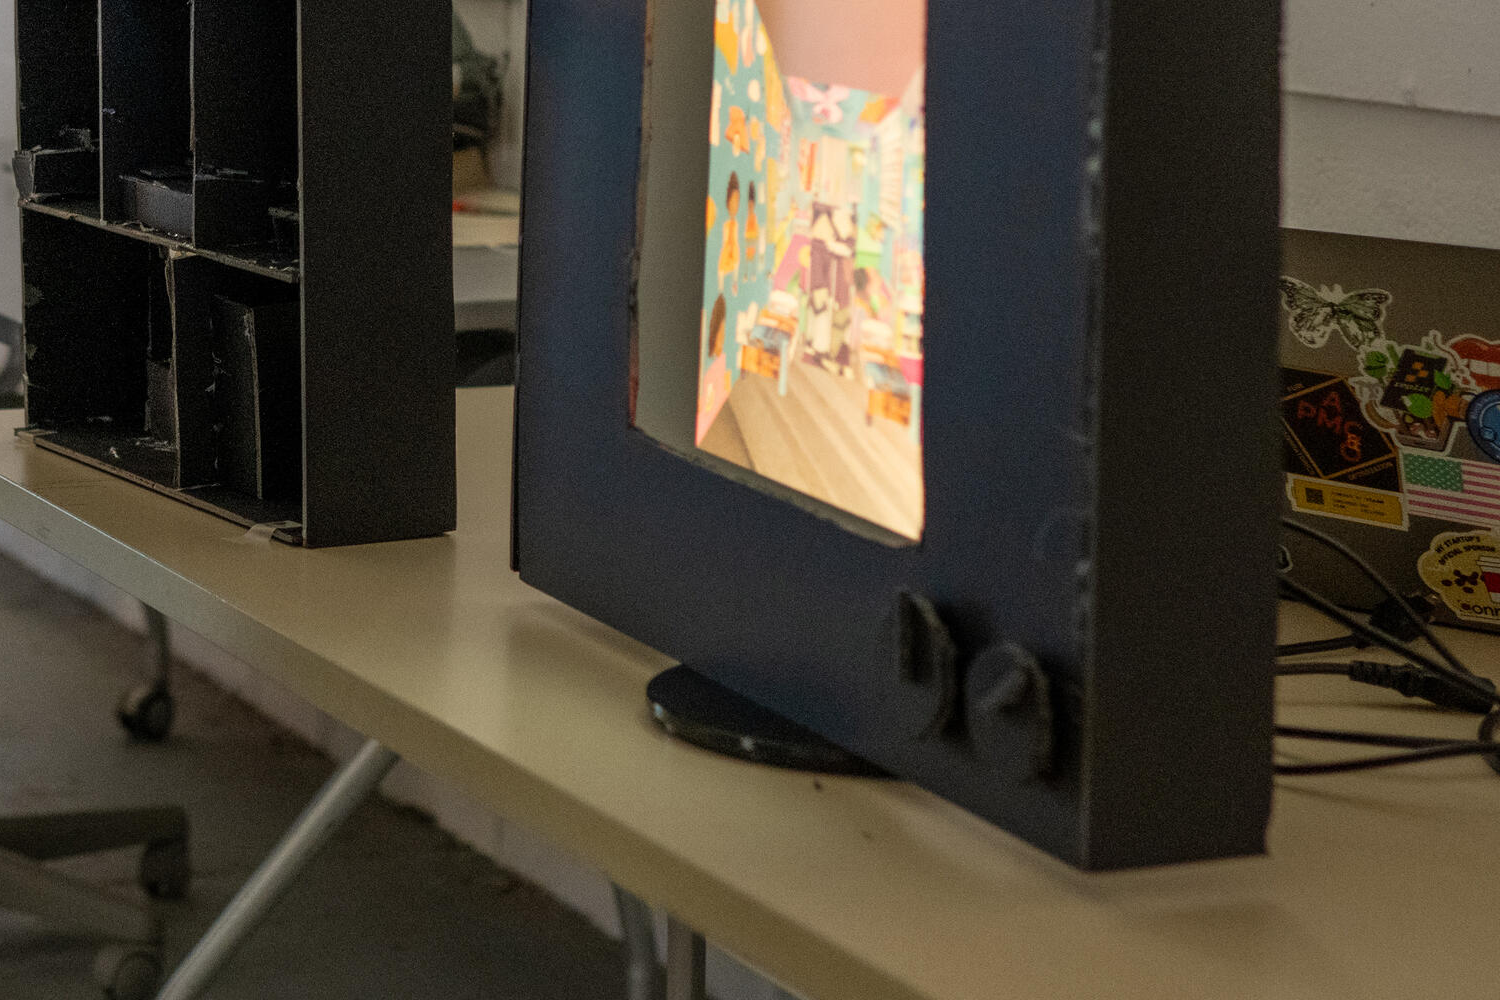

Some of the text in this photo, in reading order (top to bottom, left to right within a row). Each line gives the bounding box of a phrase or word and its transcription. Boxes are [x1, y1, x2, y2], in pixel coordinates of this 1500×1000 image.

[1443, 536, 1481, 548] STARTUP'S
[1438, 544, 1496, 565] OFFICIAL SPONSOR
